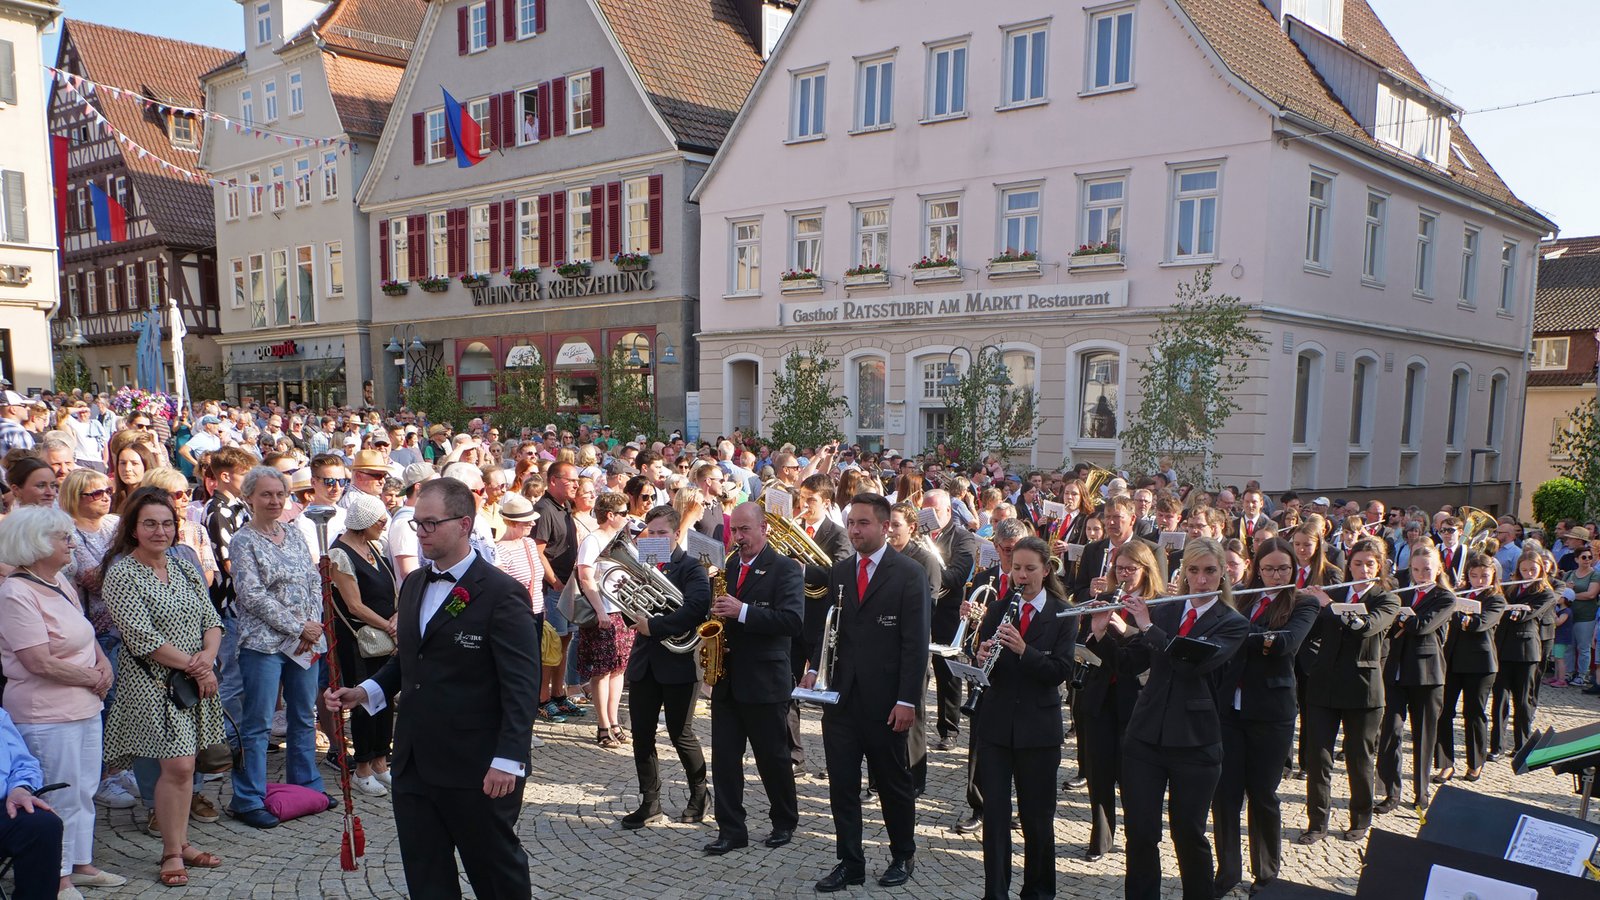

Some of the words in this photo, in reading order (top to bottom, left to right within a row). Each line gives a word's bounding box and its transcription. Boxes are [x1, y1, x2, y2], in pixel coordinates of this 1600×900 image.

[471, 282, 541, 306] VAIHINGER
[547, 270, 656, 299] KREISZEITUNG
[793, 307, 839, 323] Gasthof
[843, 301, 934, 320] RATSSTUBEN
[938, 299, 960, 314] AM
[965, 293, 1022, 313] MARKT
[1027, 291, 1111, 309] Restaurant
